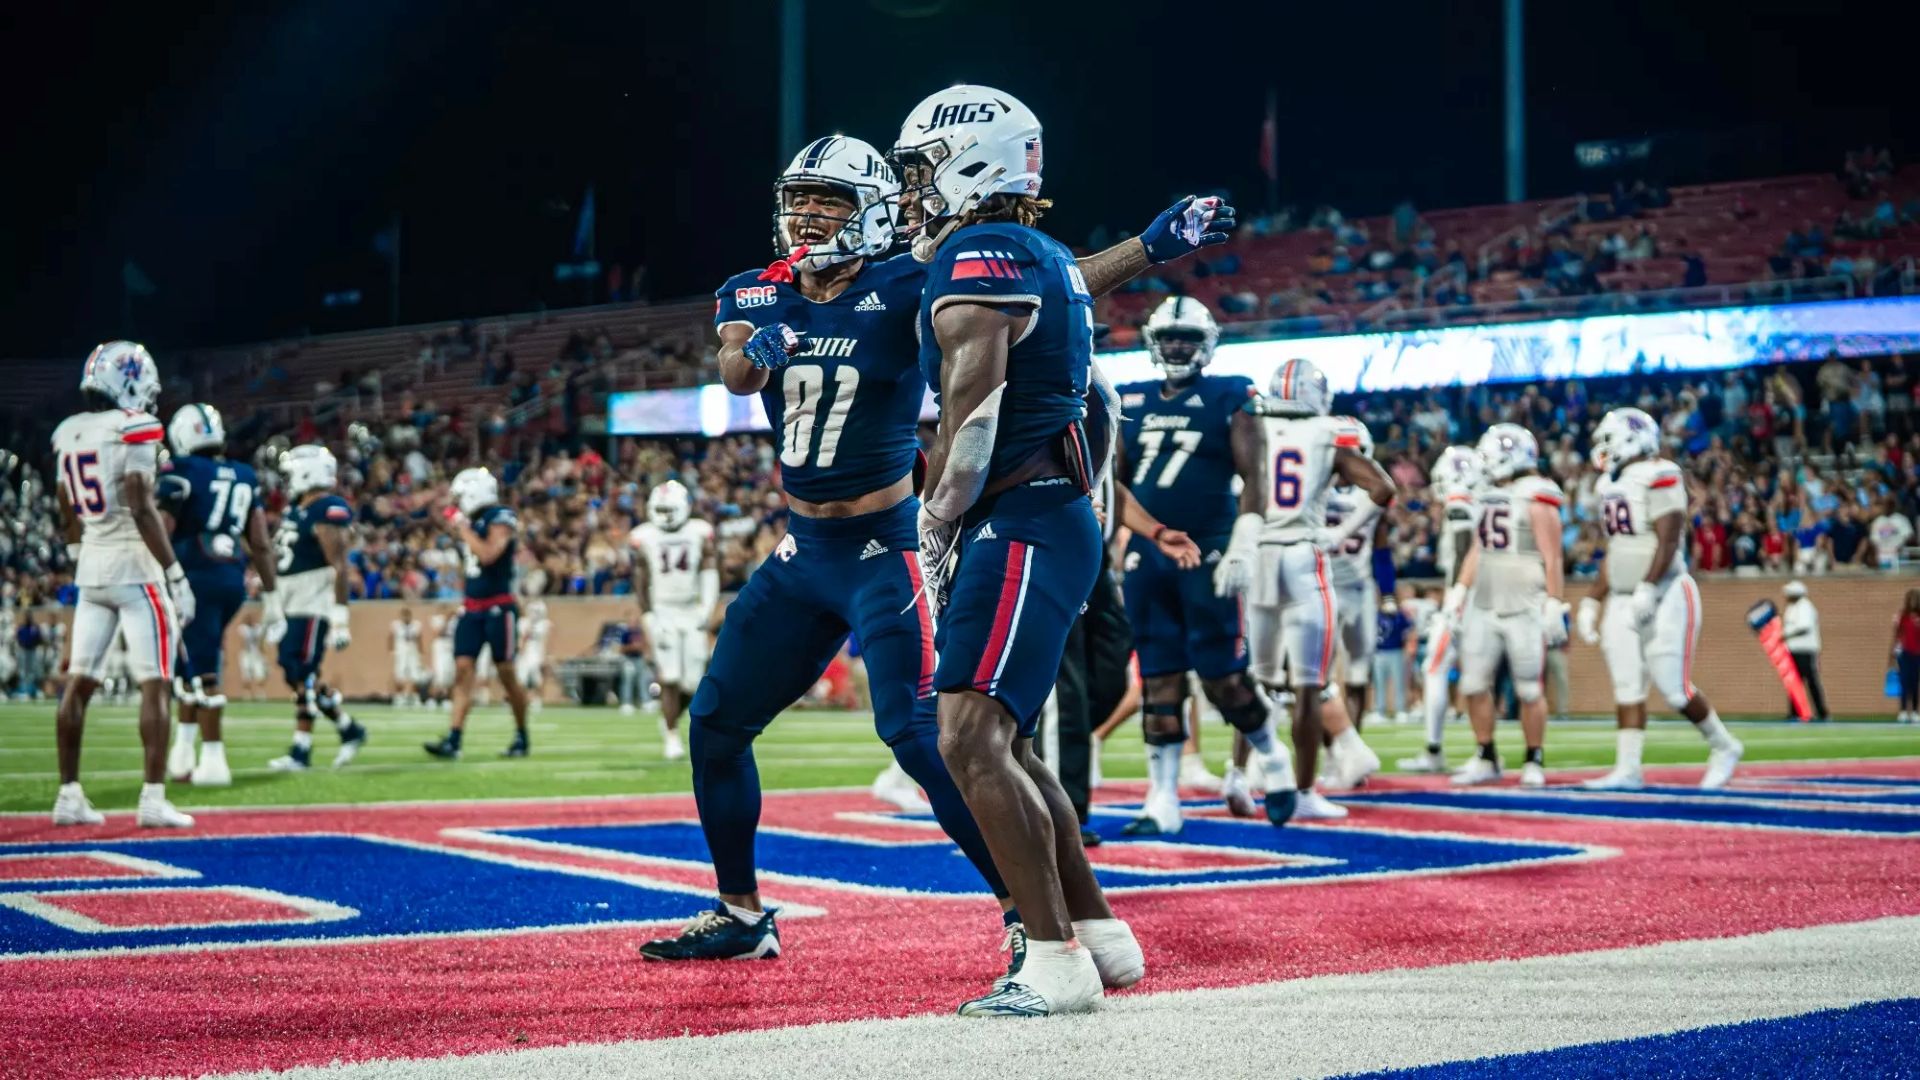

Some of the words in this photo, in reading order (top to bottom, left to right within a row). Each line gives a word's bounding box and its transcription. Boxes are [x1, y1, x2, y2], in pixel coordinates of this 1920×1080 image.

[922, 103, 996, 134] JAGS
[860, 153, 899, 185] JAG
[736, 286, 777, 309] SBC
[854, 303, 887, 312] adidas
[780, 365, 860, 467] 81
[1133, 430, 1203, 488] 77
[62, 450, 108, 516] 15
[1273, 447, 1305, 511] 6
[206, 479, 253, 535] 79
[1478, 507, 1510, 550] 45
[659, 546, 690, 574] 14
[859, 547, 889, 561] adidas
